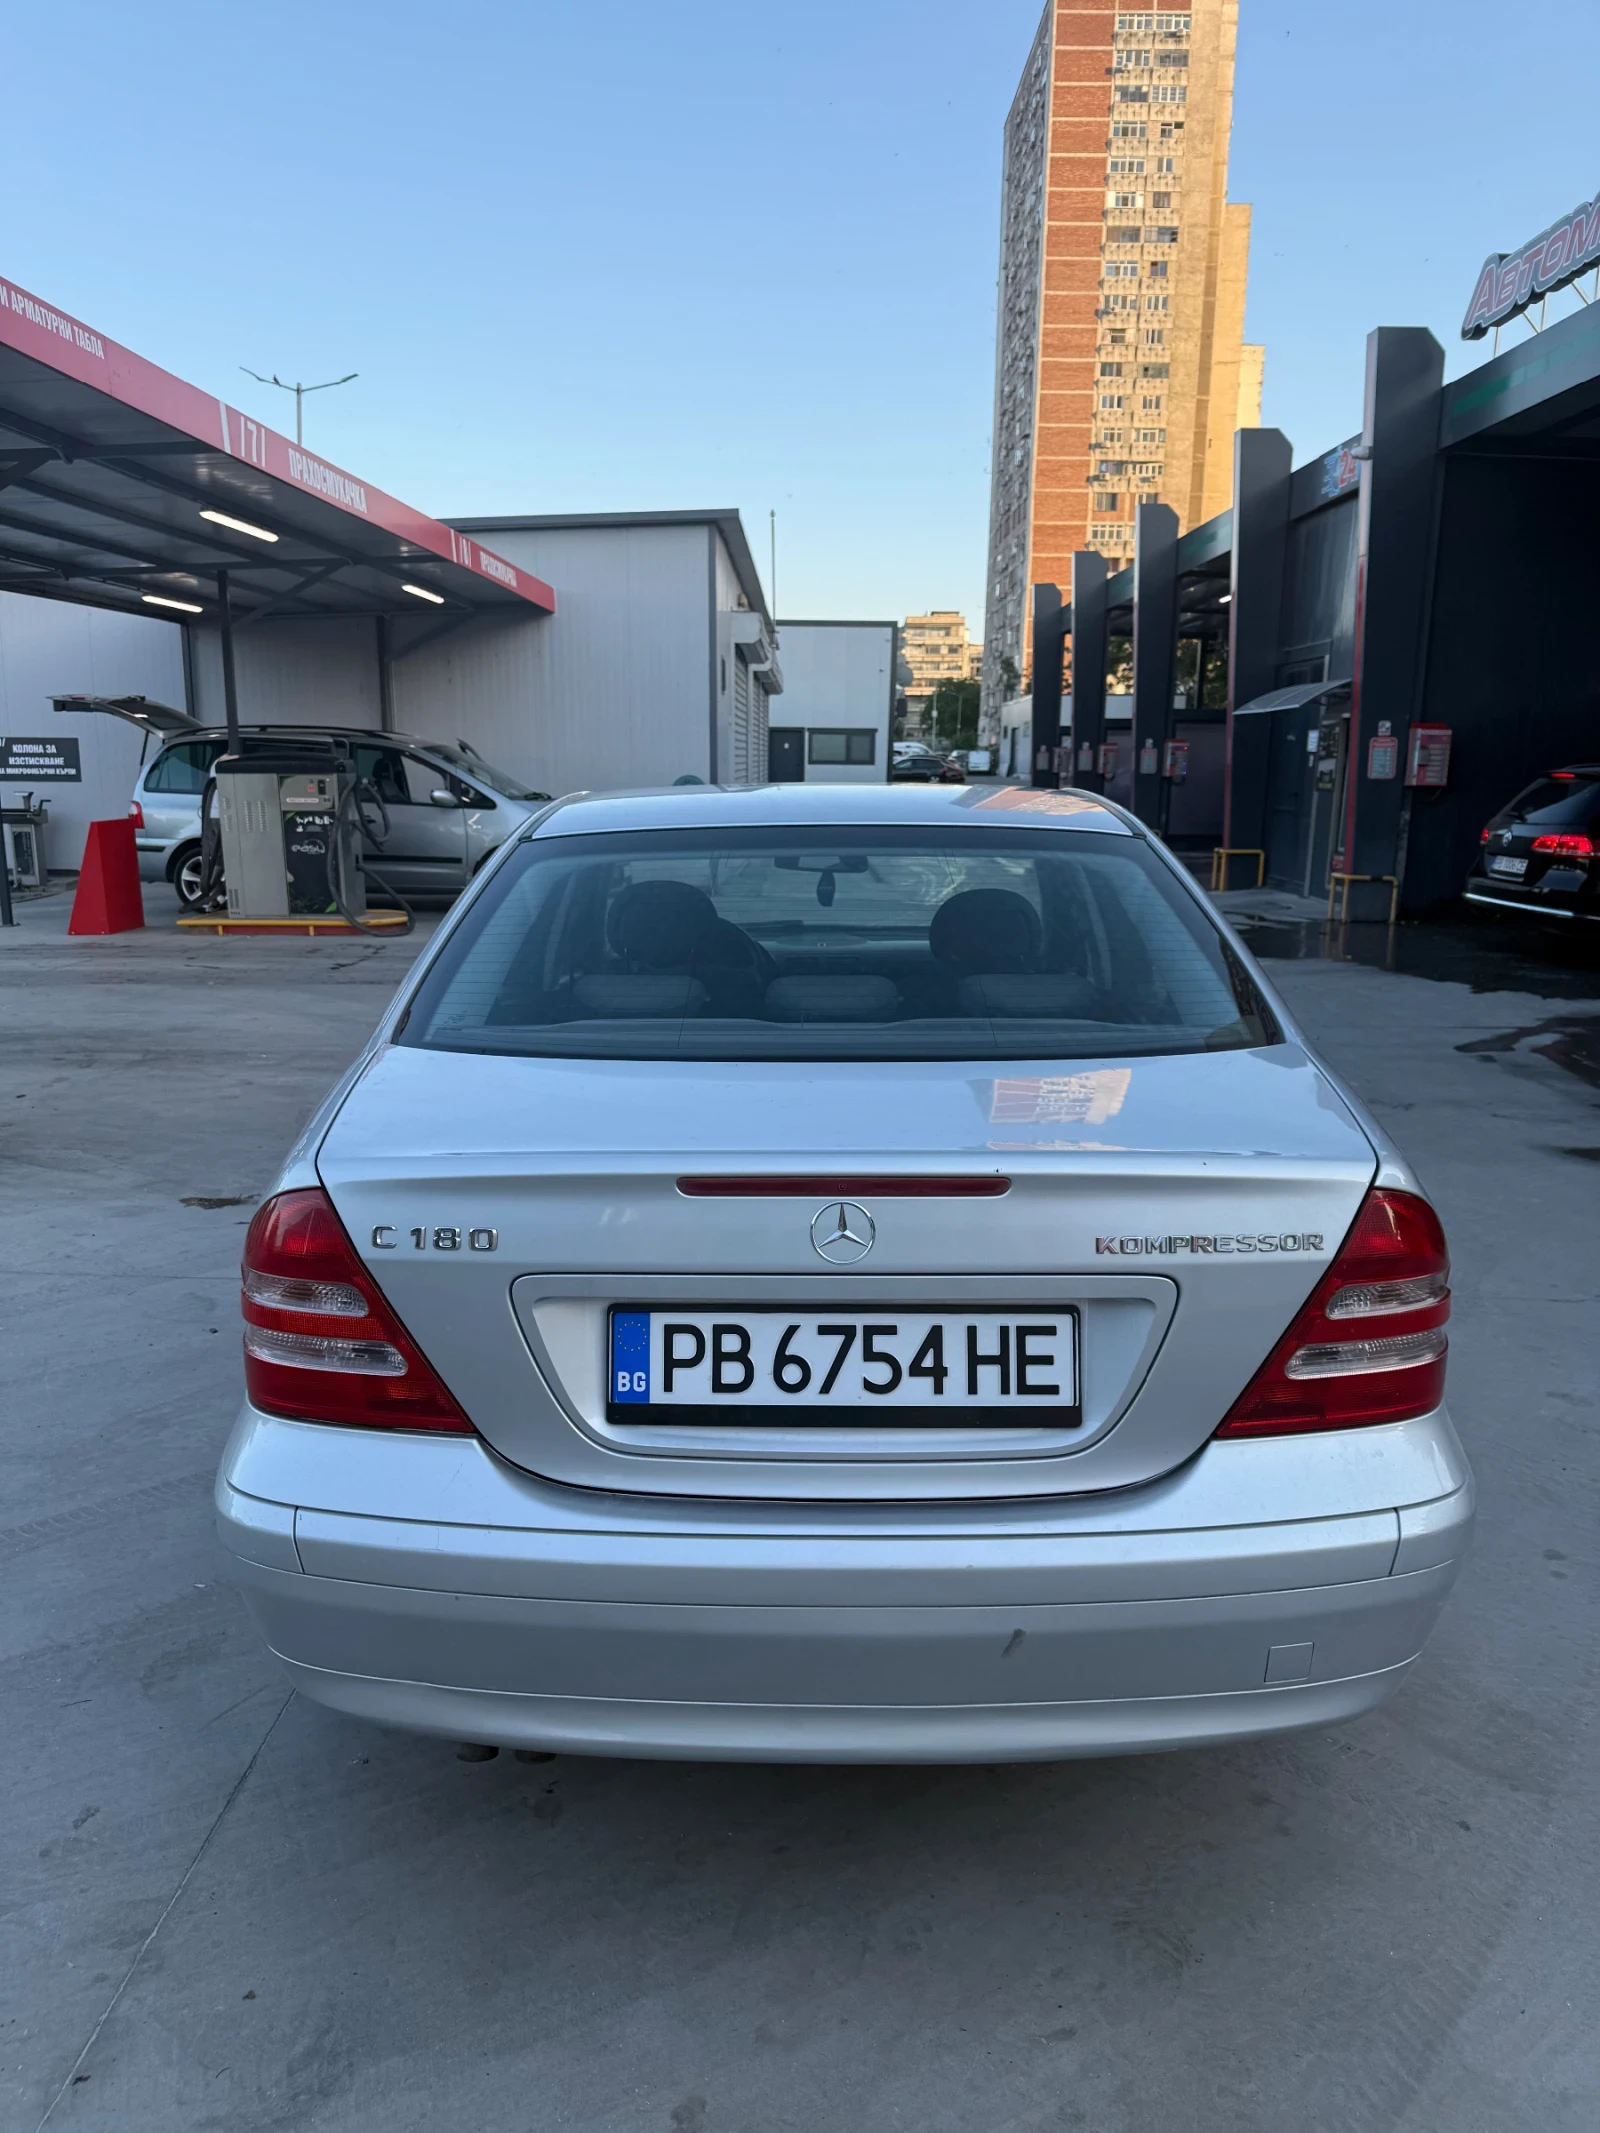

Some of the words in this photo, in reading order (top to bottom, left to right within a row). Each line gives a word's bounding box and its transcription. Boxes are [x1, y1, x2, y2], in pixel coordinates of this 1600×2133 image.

[11, 290, 73, 342] АРМАТУРНИ
[73, 325, 104, 359] ТАБЛА
[288, 448, 367, 513] ПРАХОСМУКАЧКА
[8, 756, 65, 765] ИЗСТИСКВАНЕ
[12, 744, 44, 754] КОЛОНА
[45, 744, 57, 754] ЗА
[372, 1225, 397, 1249] C
[410, 1225, 498, 1252] 180
[1095, 1232, 1325, 1255] KOMPRESSOR
[617, 1371, 647, 1392] BG
